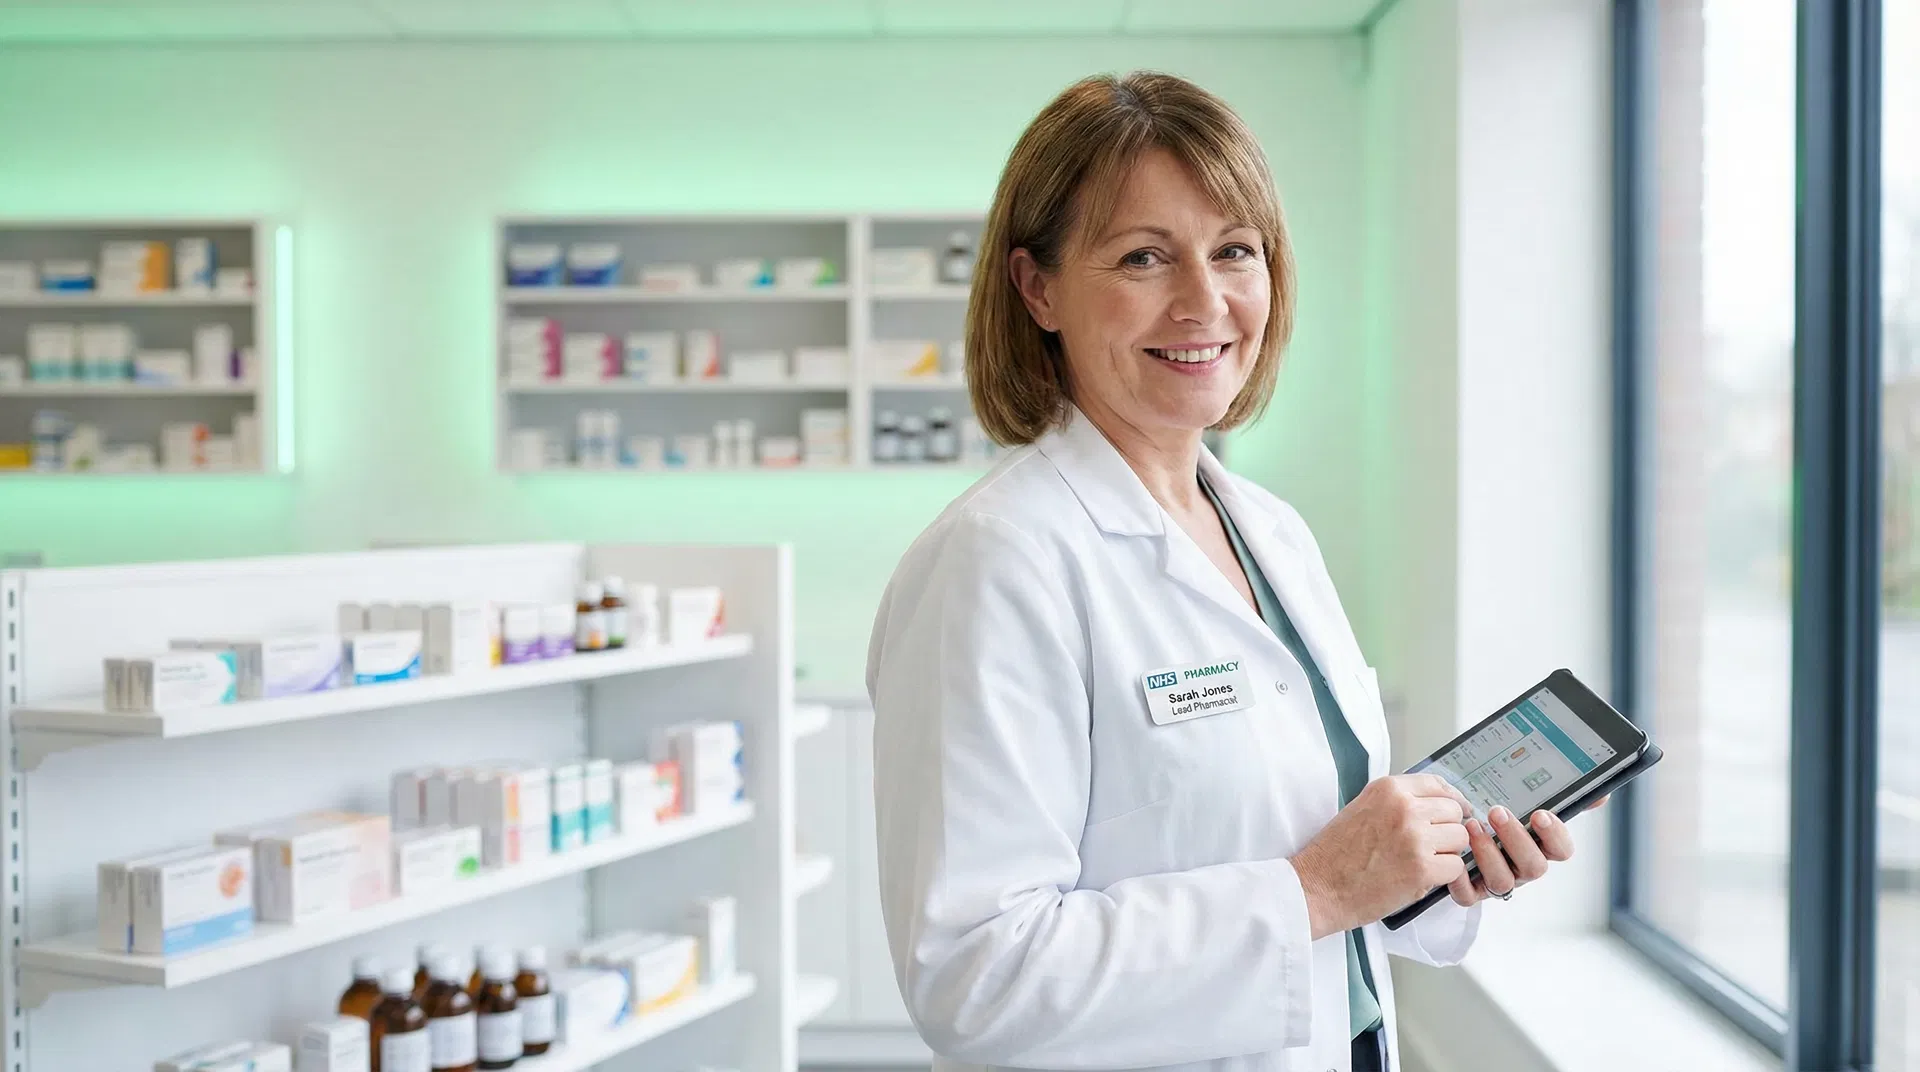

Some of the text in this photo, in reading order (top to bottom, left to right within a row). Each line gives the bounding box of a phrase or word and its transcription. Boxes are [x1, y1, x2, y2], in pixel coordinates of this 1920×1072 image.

[1148, 661, 1239, 689] NHS PHARMACY
[1168, 684, 1233, 703] Sarah Jones
[1171, 702, 1193, 716] Lead
